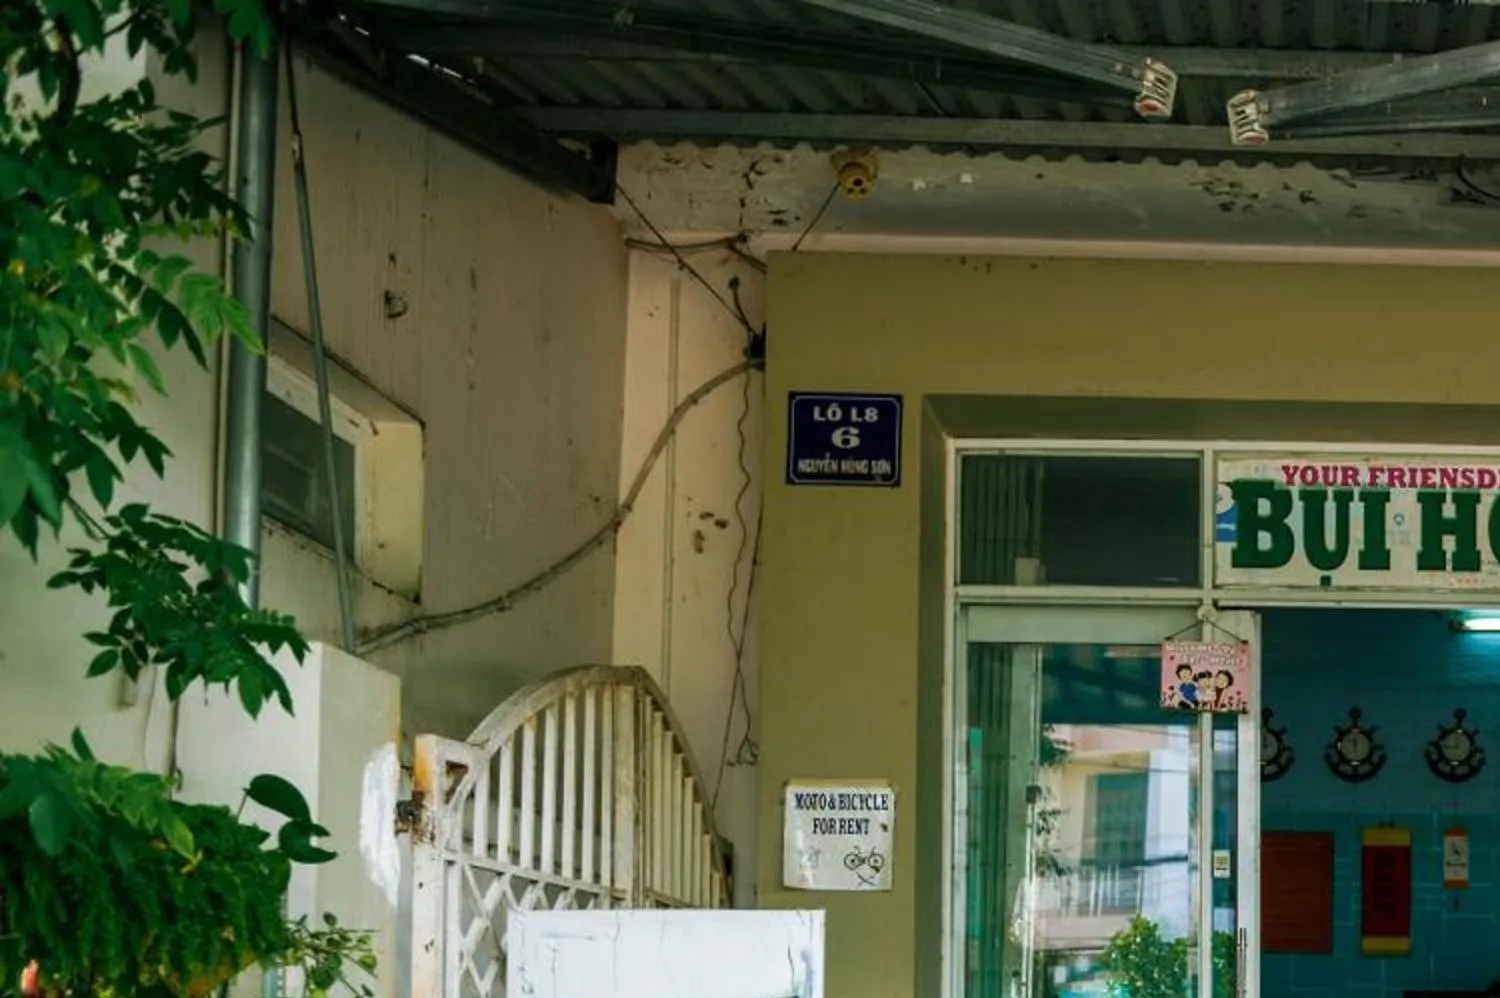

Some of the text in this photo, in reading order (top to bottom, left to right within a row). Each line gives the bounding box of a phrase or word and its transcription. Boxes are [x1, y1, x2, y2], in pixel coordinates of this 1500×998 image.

[831, 426, 861, 449] 6
[1282, 465, 1360, 487] YOUR
[813, 818, 870, 835] FOR RENT
